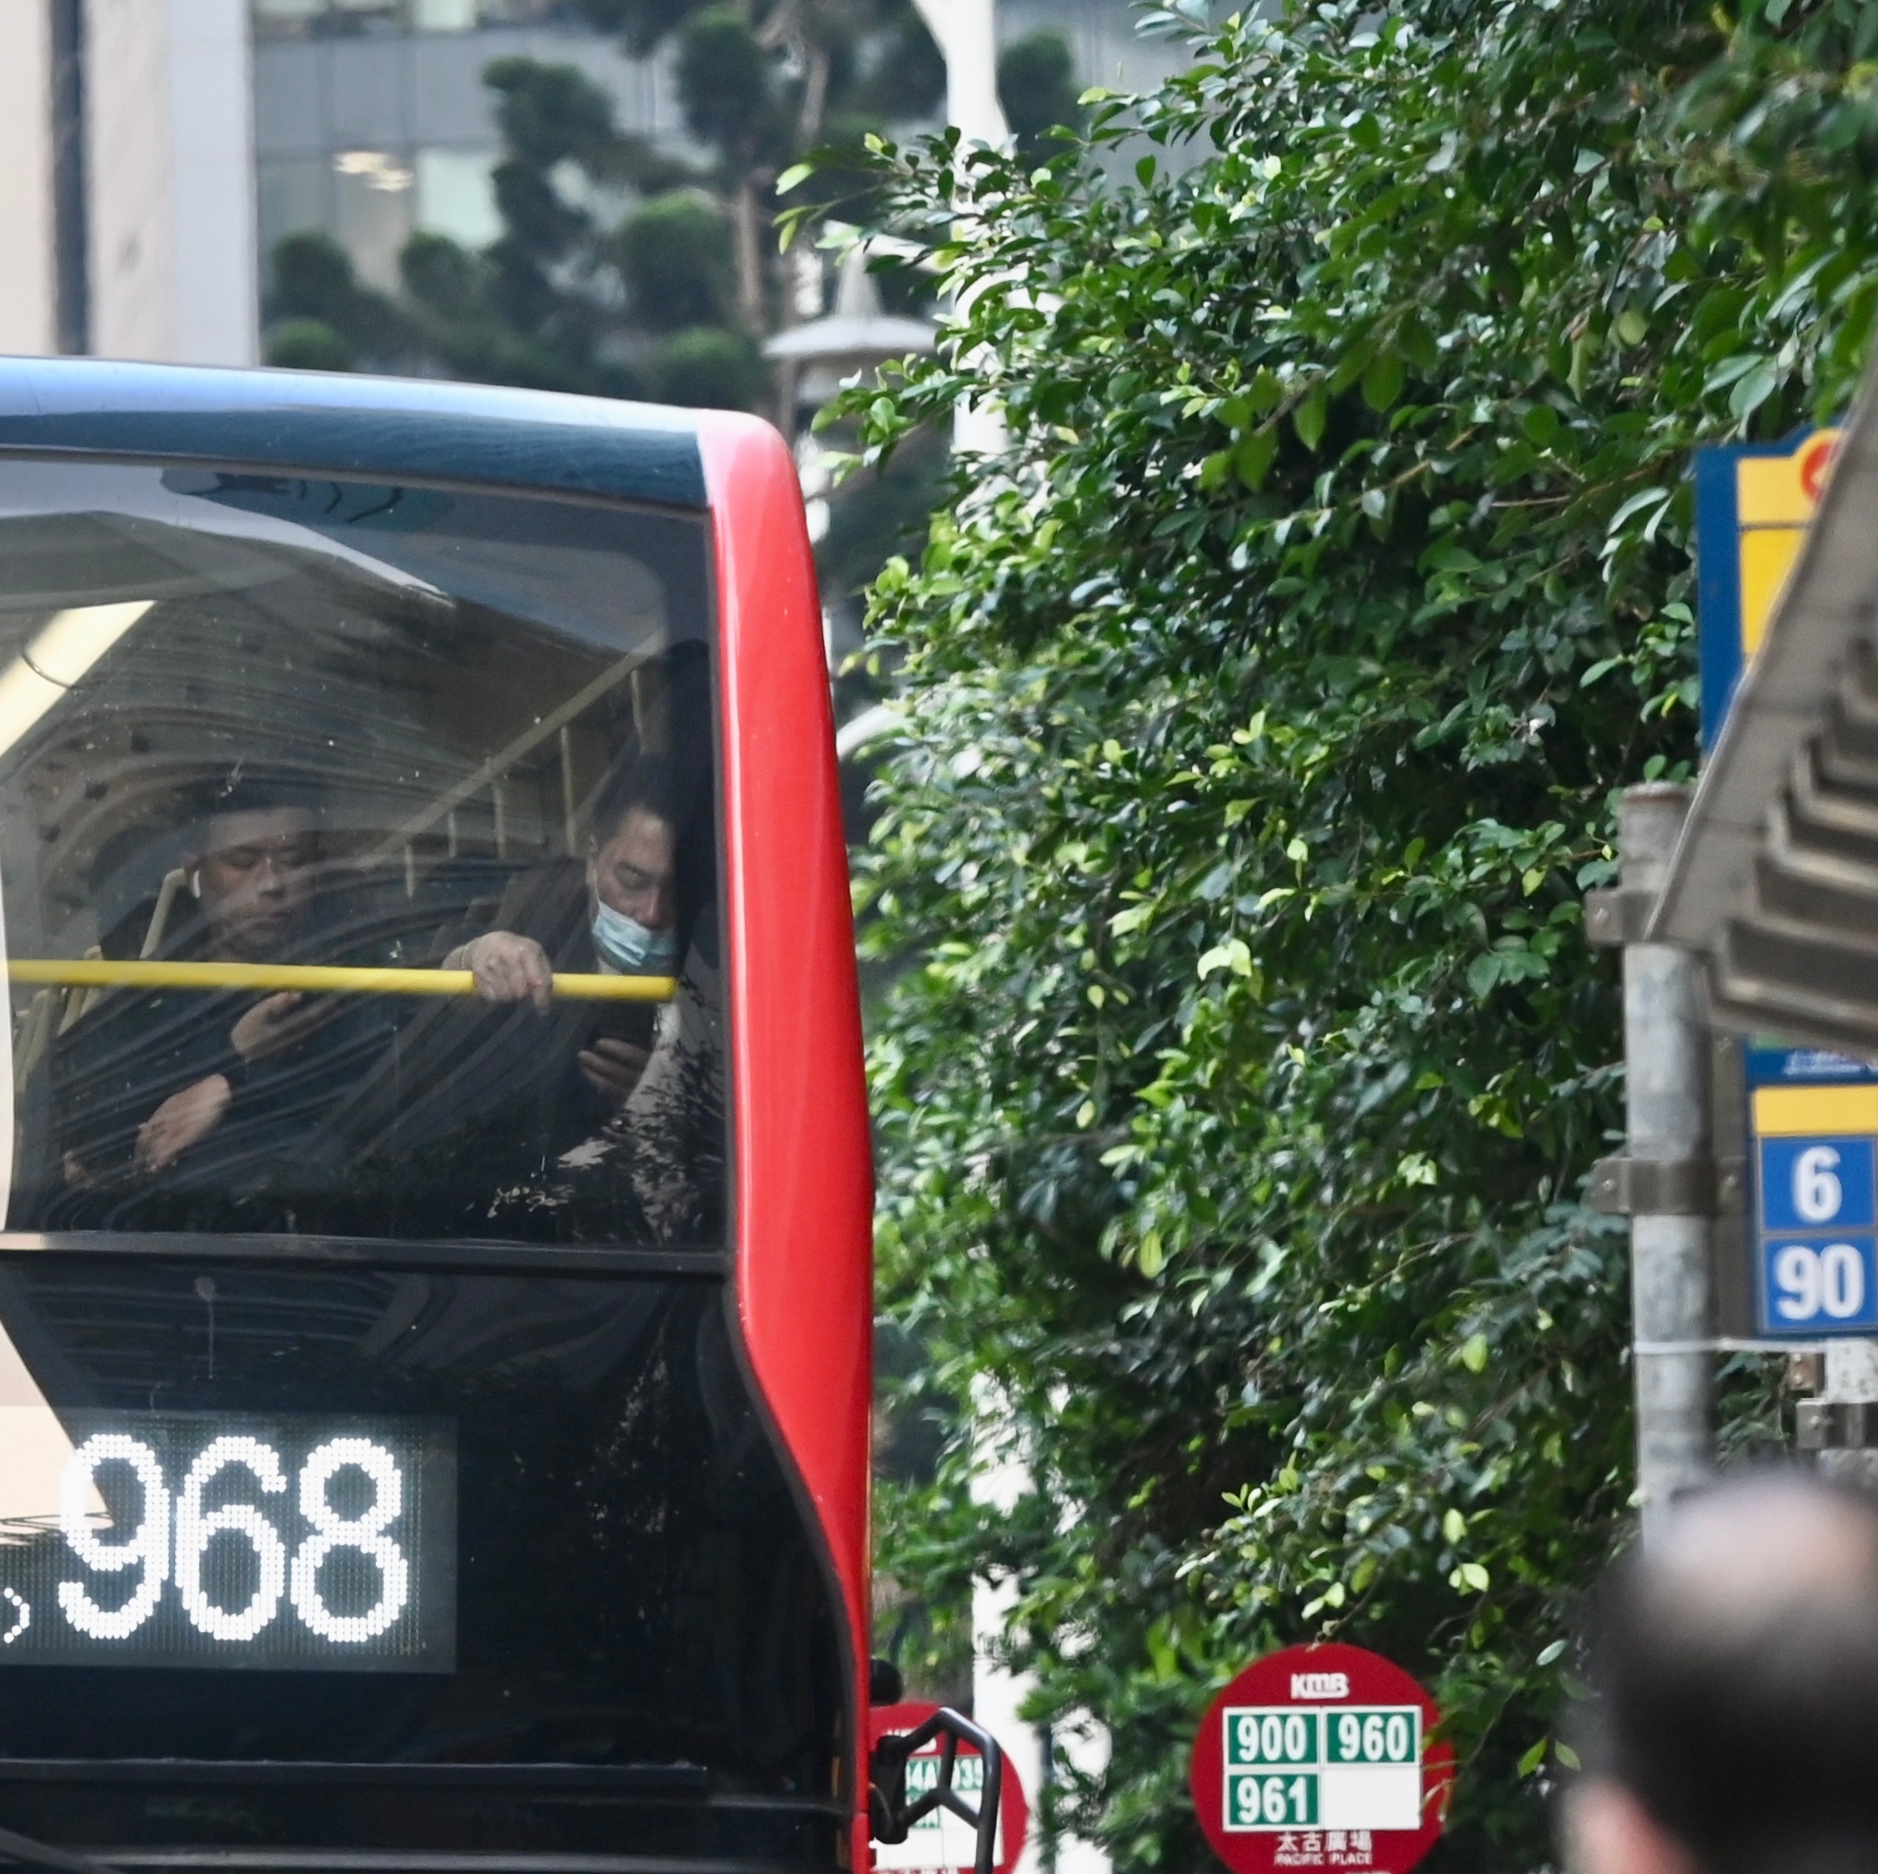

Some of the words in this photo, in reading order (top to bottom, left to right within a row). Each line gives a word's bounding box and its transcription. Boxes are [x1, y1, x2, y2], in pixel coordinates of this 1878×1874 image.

[1792, 1145, 1842, 1223] 6
[1774, 1243, 1865, 1321] 90
[57, 1431, 409, 1644] 968
[1290, 1672, 1350, 1700] KMB
[1236, 1715, 1307, 1762] 900
[1337, 1713, 1410, 1762] 960
[1236, 1776, 1309, 1824] 961
[1273, 1852, 1324, 1867] PACIFIC
[1328, 1851, 1373, 1866] PLACE
[1276, 1830, 1373, 1852] 太古廣場
